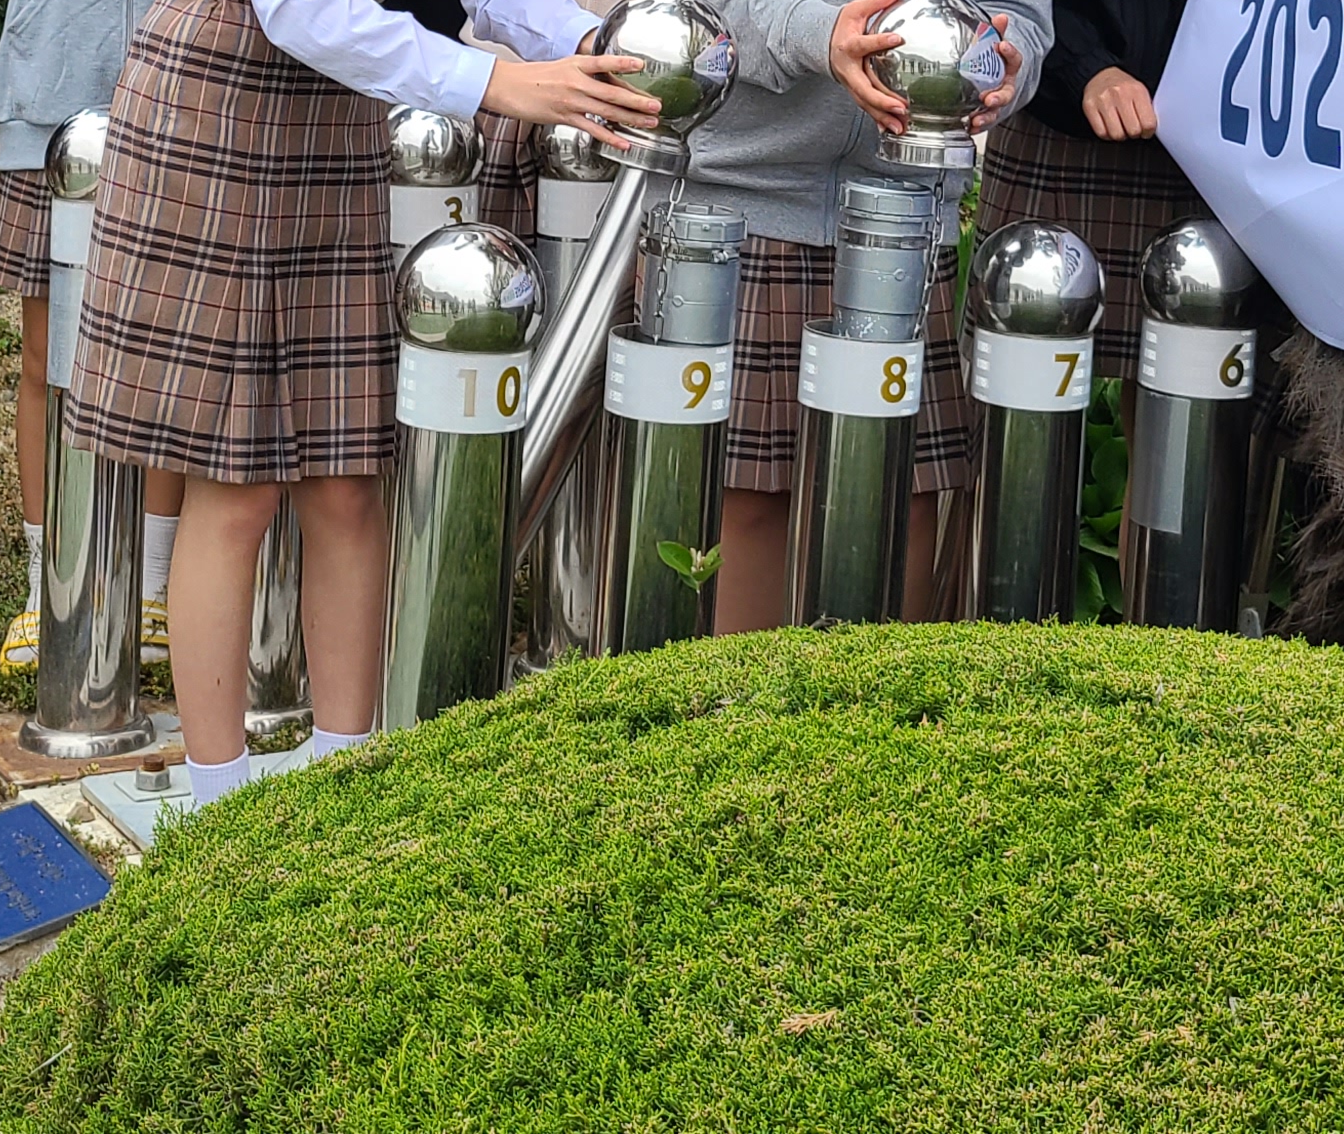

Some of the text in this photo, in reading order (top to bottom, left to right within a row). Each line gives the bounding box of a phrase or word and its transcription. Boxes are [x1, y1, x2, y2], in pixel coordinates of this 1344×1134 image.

[681, 361, 712, 409] 9
[880, 356, 907, 403] 8
[1054, 353, 1081, 397] 7
[1219, 343, 1245, 388] 6
[456, 366, 522, 418] 10
